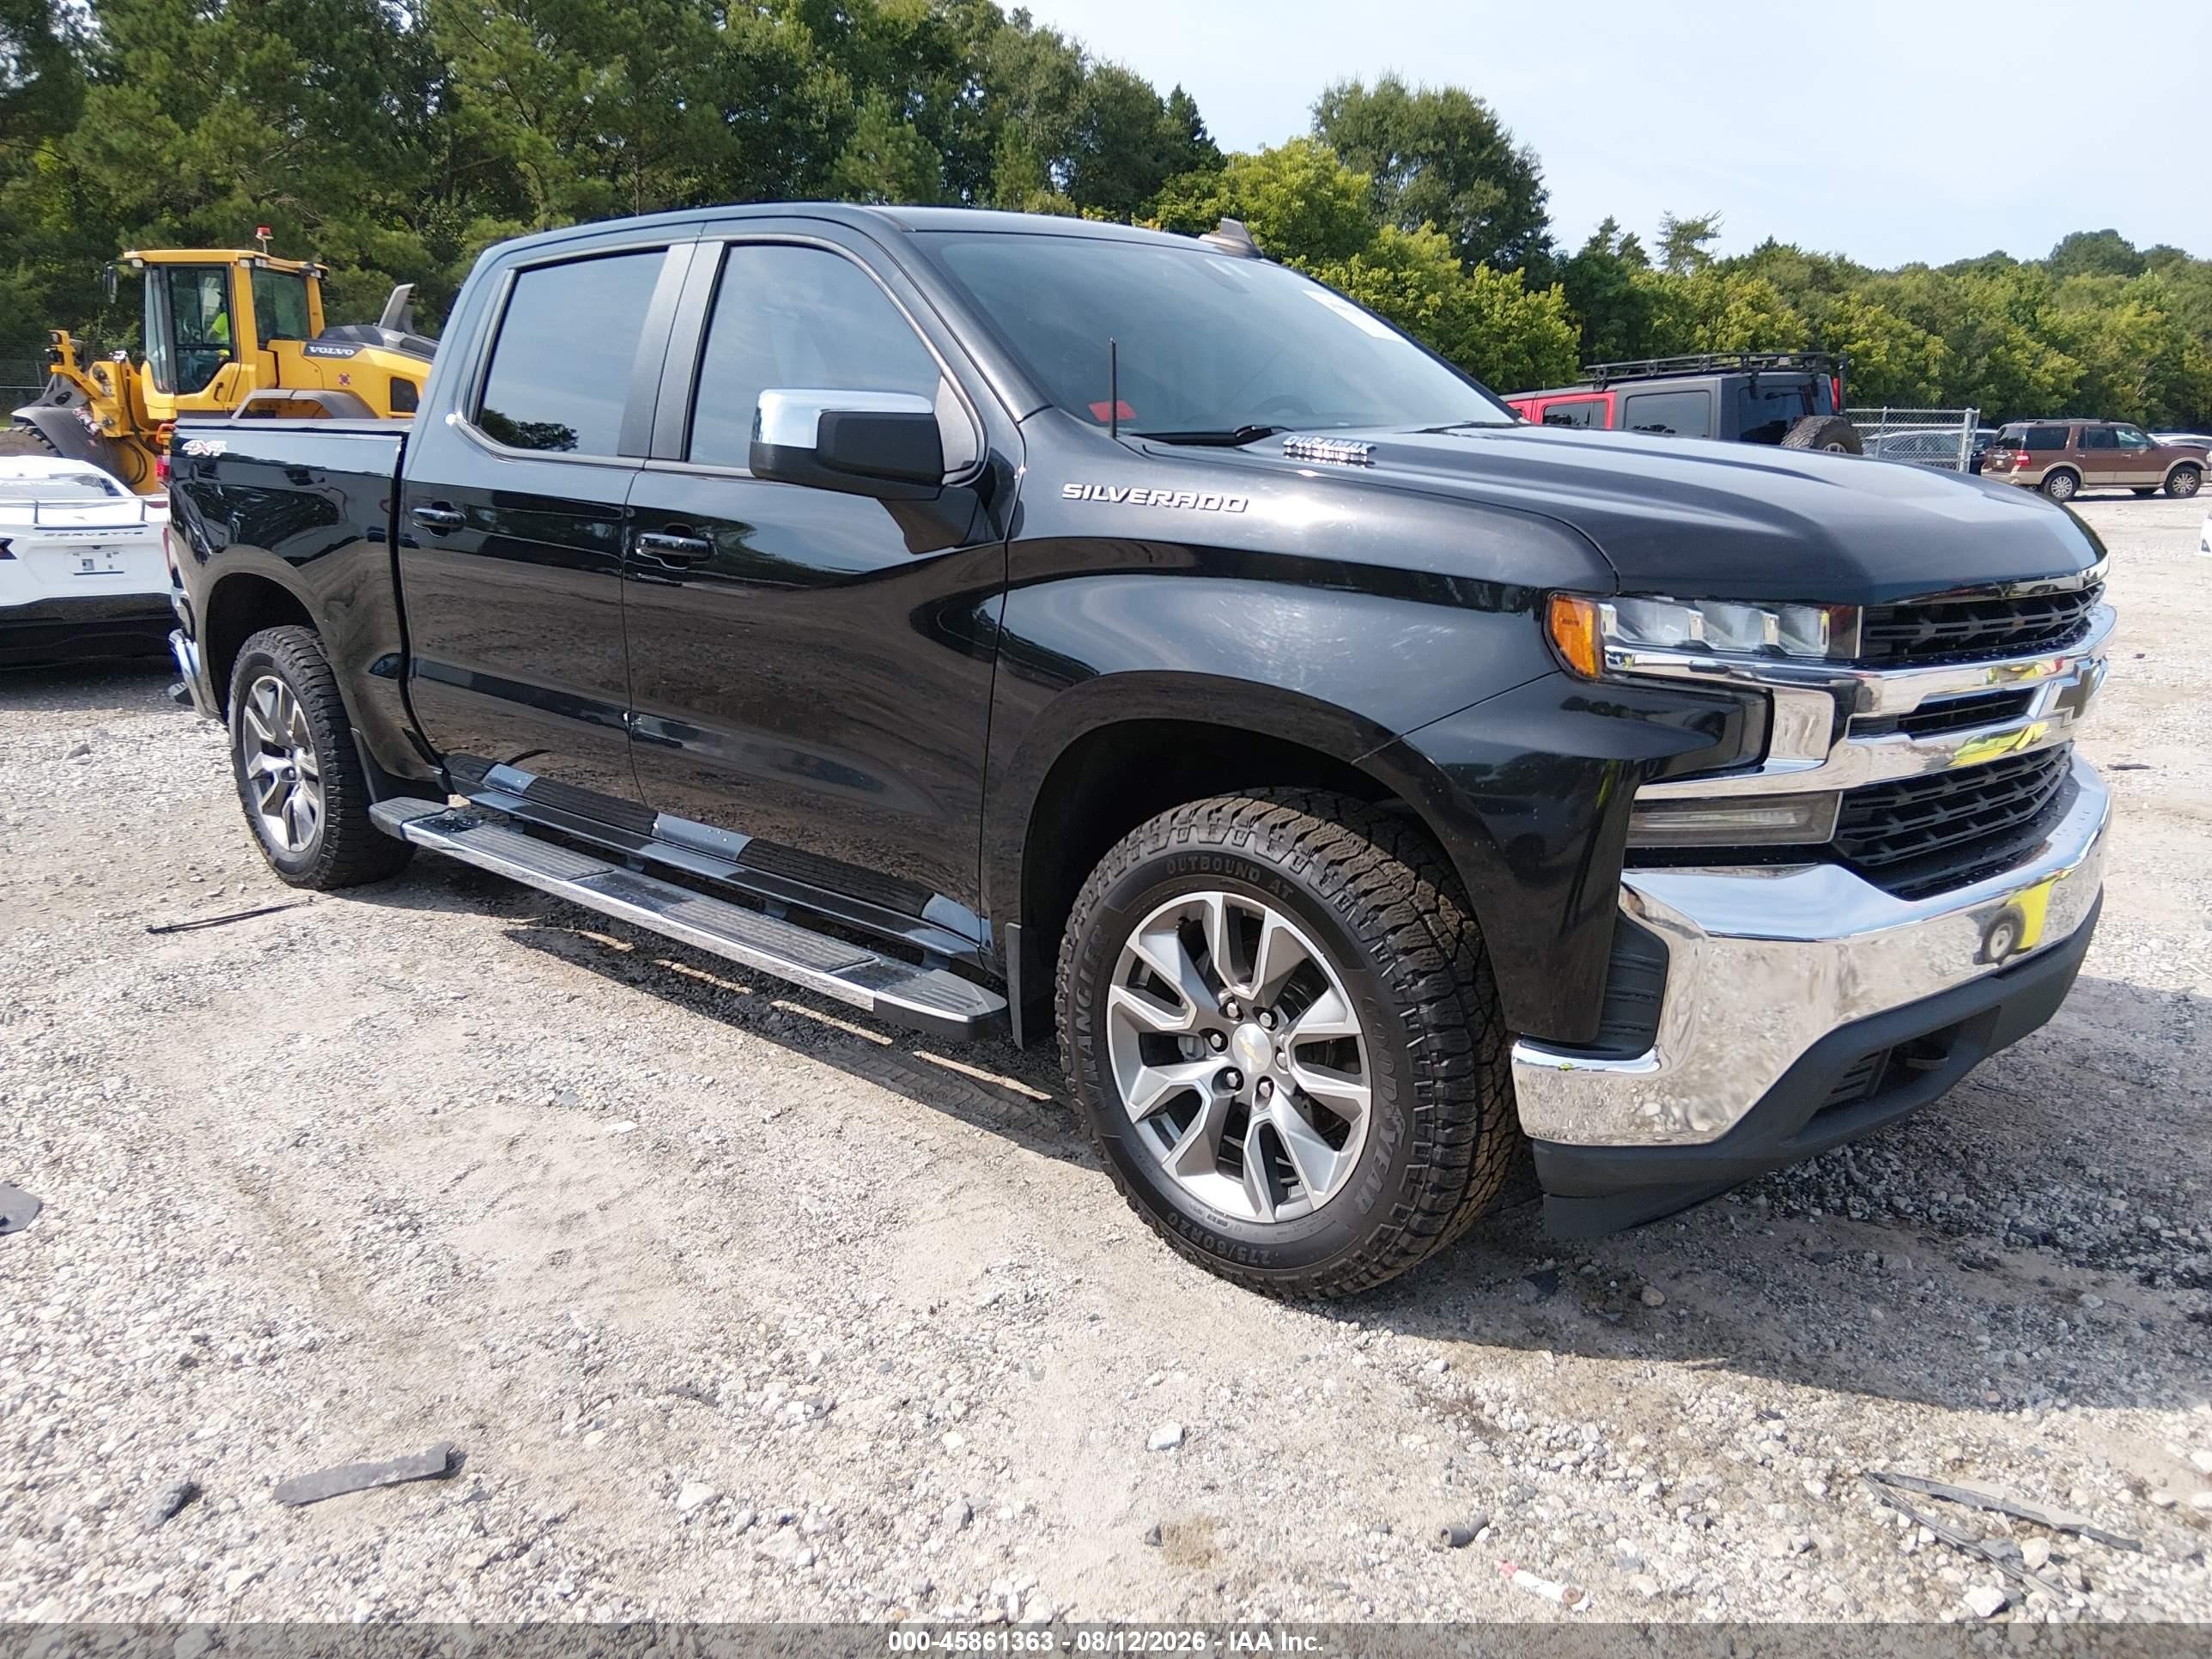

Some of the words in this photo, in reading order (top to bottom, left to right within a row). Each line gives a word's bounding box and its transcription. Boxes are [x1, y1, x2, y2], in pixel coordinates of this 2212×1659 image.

[309, 346, 355, 356] VOLVO
[1062, 483, 1249, 513] SILVERADO
[1165, 855, 1261, 883] OUTBOUND
[1266, 878, 1294, 901] AT
[1073, 924, 1111, 1113] WRANGLER
[1355, 995, 1407, 1215] GOODYEAR
[1167, 1212, 1272, 1265] 275/60R20
